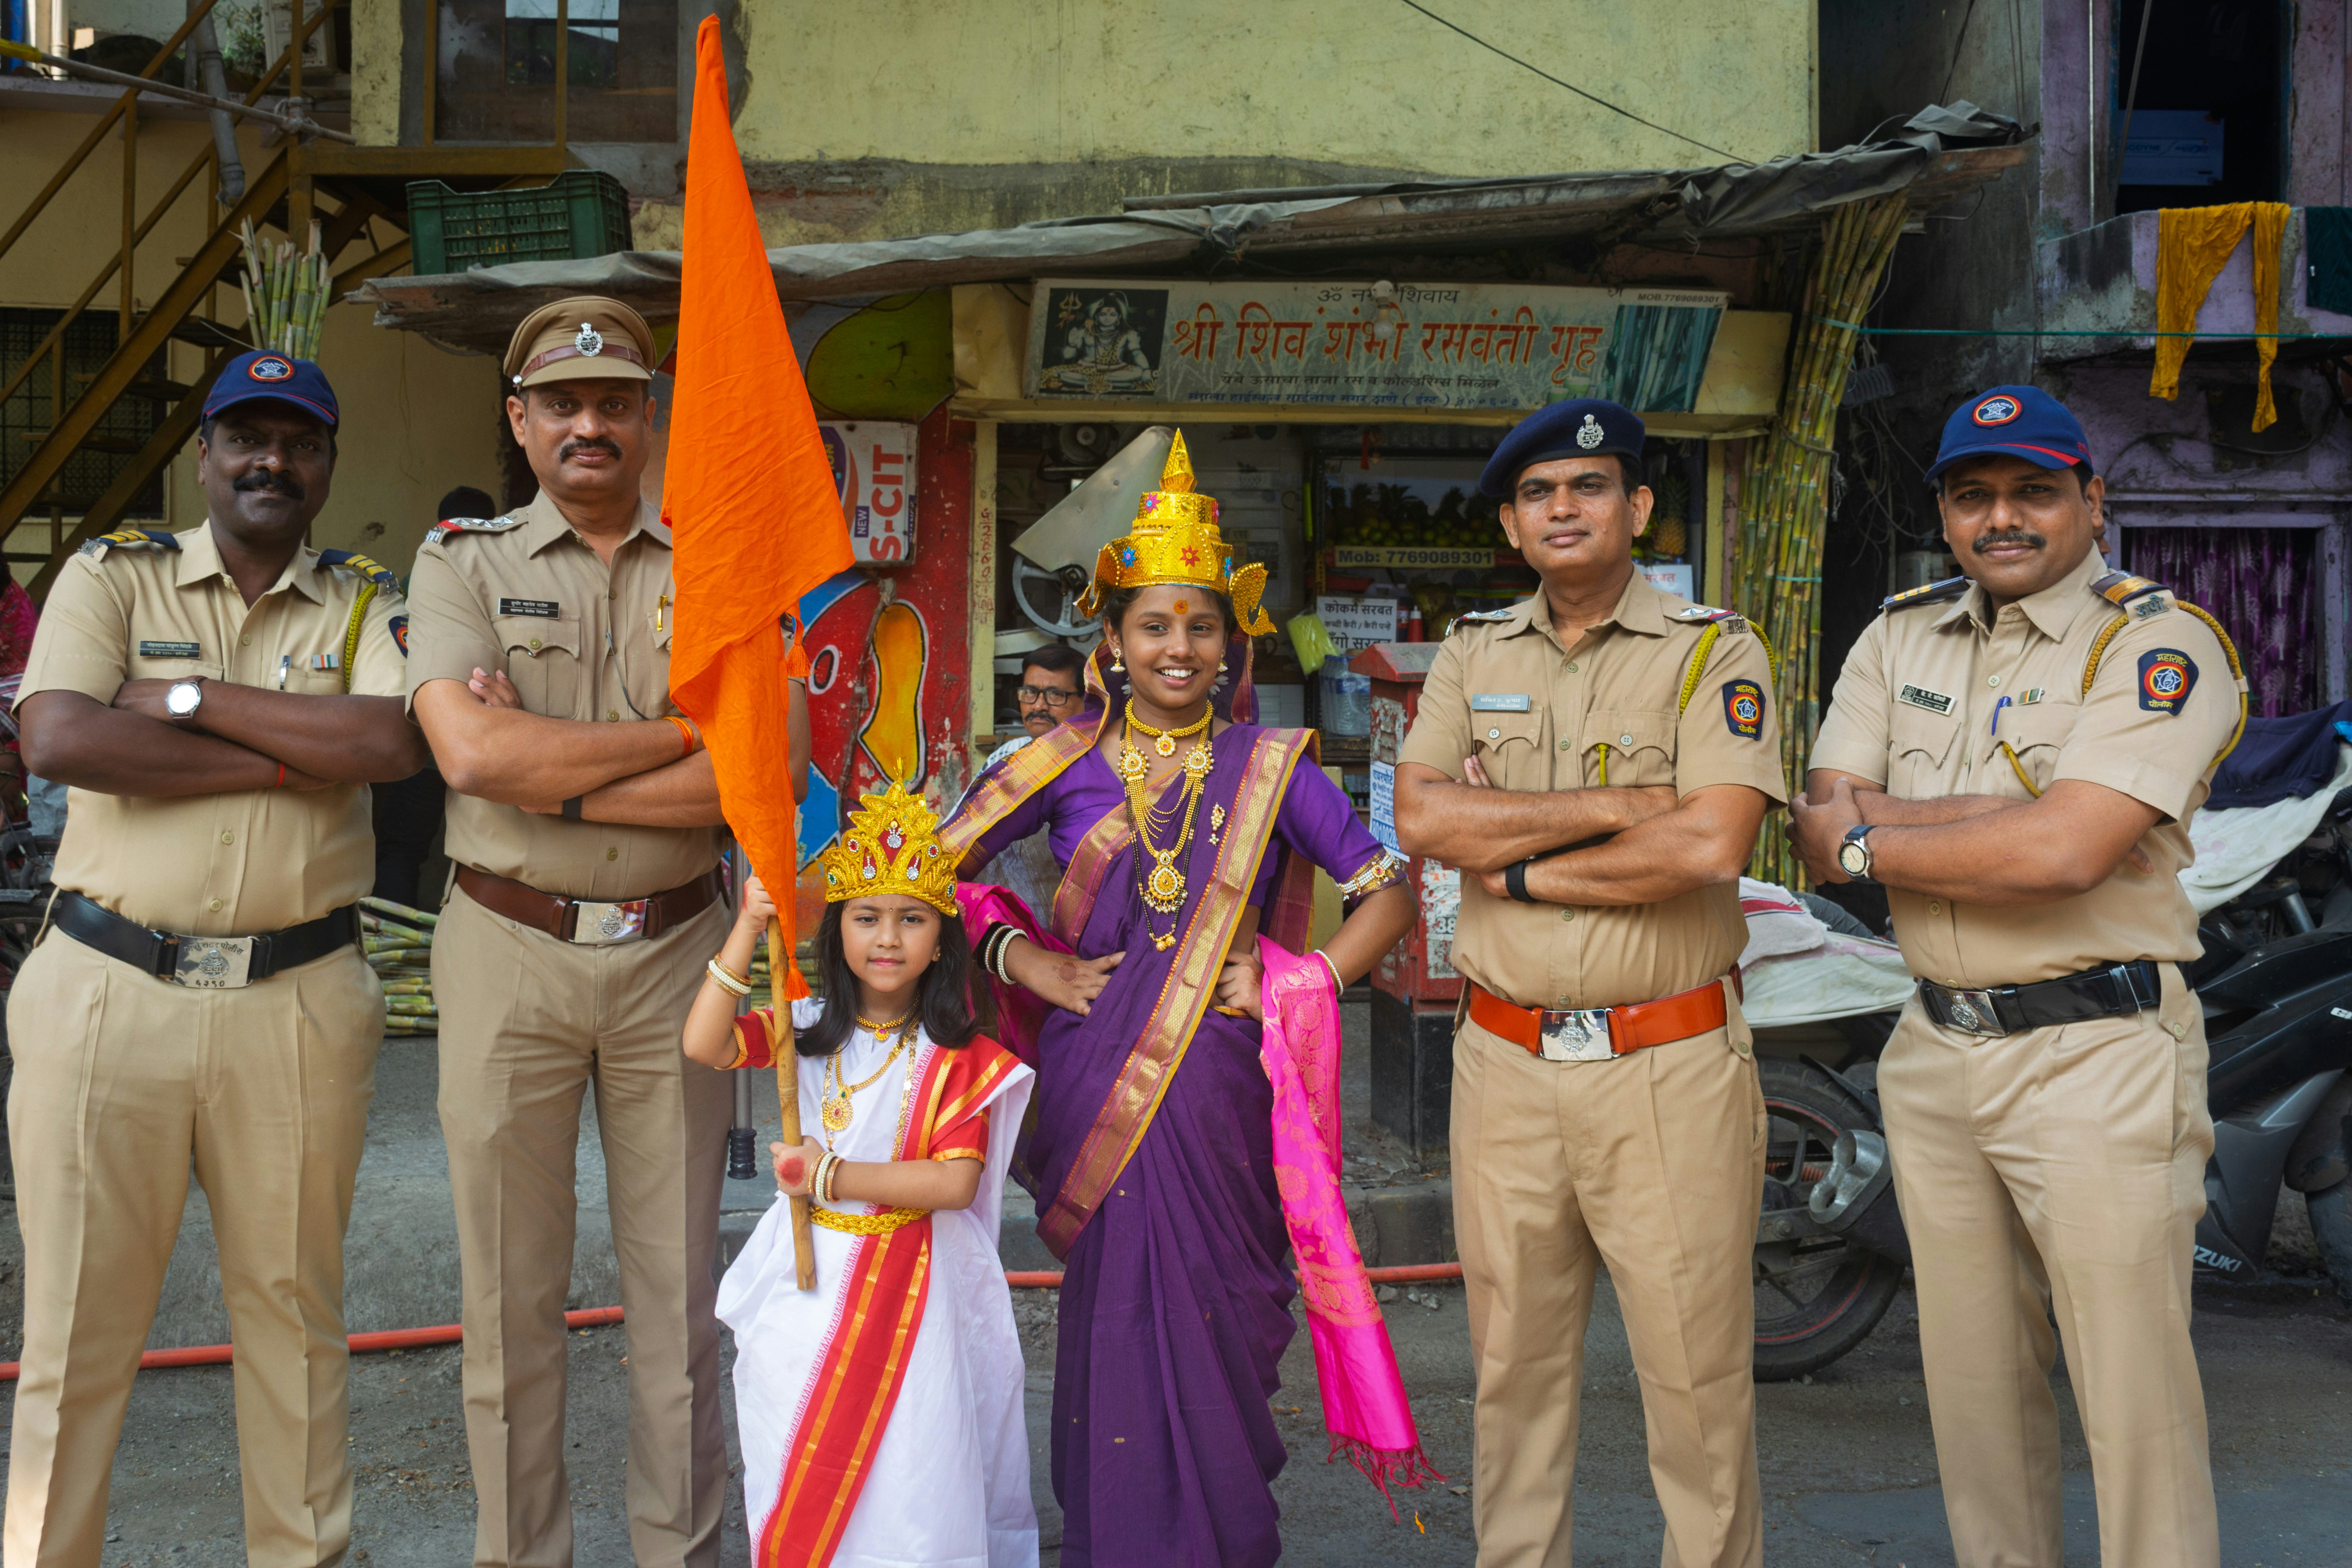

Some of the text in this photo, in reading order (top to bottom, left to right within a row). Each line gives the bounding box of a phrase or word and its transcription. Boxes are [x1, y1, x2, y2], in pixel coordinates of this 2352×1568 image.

[1399, 285, 1460, 303] शिवाय
[1173, 301, 1224, 363] श्री
[1236, 301, 1313, 365] शिव
[1421, 306, 1540, 366] रसवंती
[1549, 326, 1604, 385] गृह
[1250, 375, 1299, 385] ऊसाचा
[1304, 376, 1339, 384] ताजा
[1345, 376, 1363, 385] रस
[858, 510, 866, 534] NEW
[1338, 550, 1491, 564] Mob: 7769089301
[1325, 600, 1393, 615] कोकम सरबत
[2156, 653, 2188, 667] महाराष्ट्र
[2148, 699, 2173, 708] पोलीस
[1738, 724, 1756, 734] पोलीस
[220, 941, 244, 955] पोलीस
